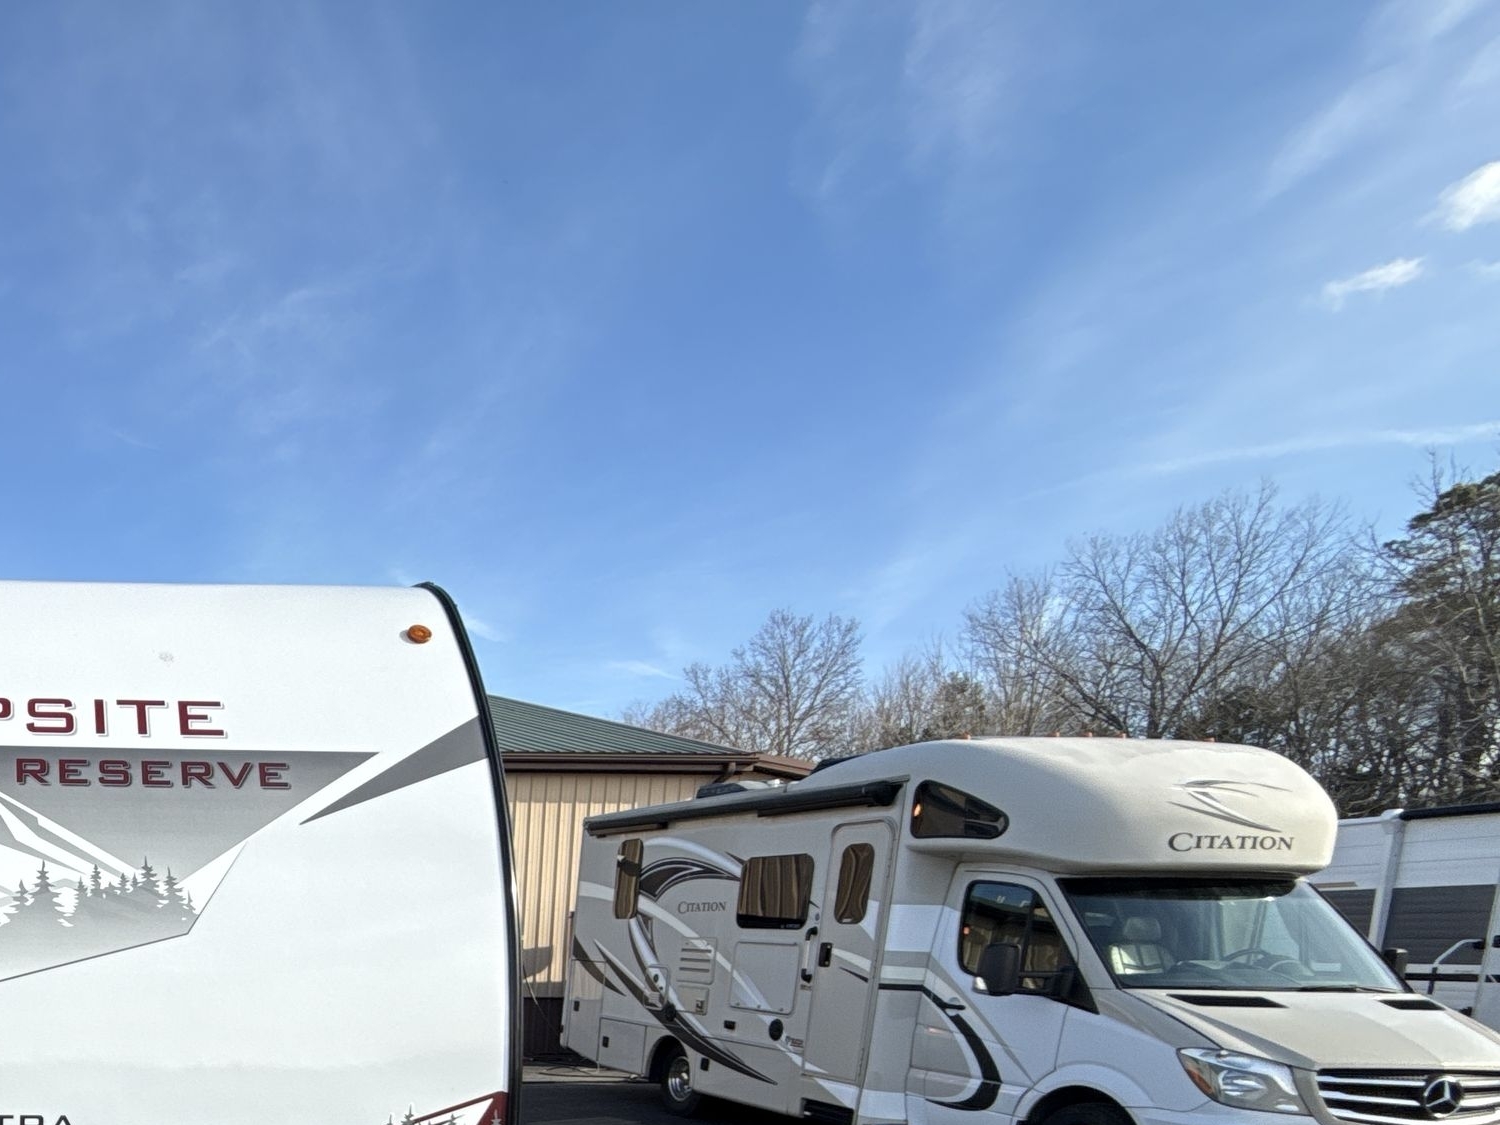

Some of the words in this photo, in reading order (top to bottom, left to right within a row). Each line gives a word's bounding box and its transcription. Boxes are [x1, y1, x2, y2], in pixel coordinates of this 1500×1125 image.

[15, 757, 291, 790] RESERVE
[1167, 832, 1295, 852] CITATION
[677, 901, 727, 915] CITATION
